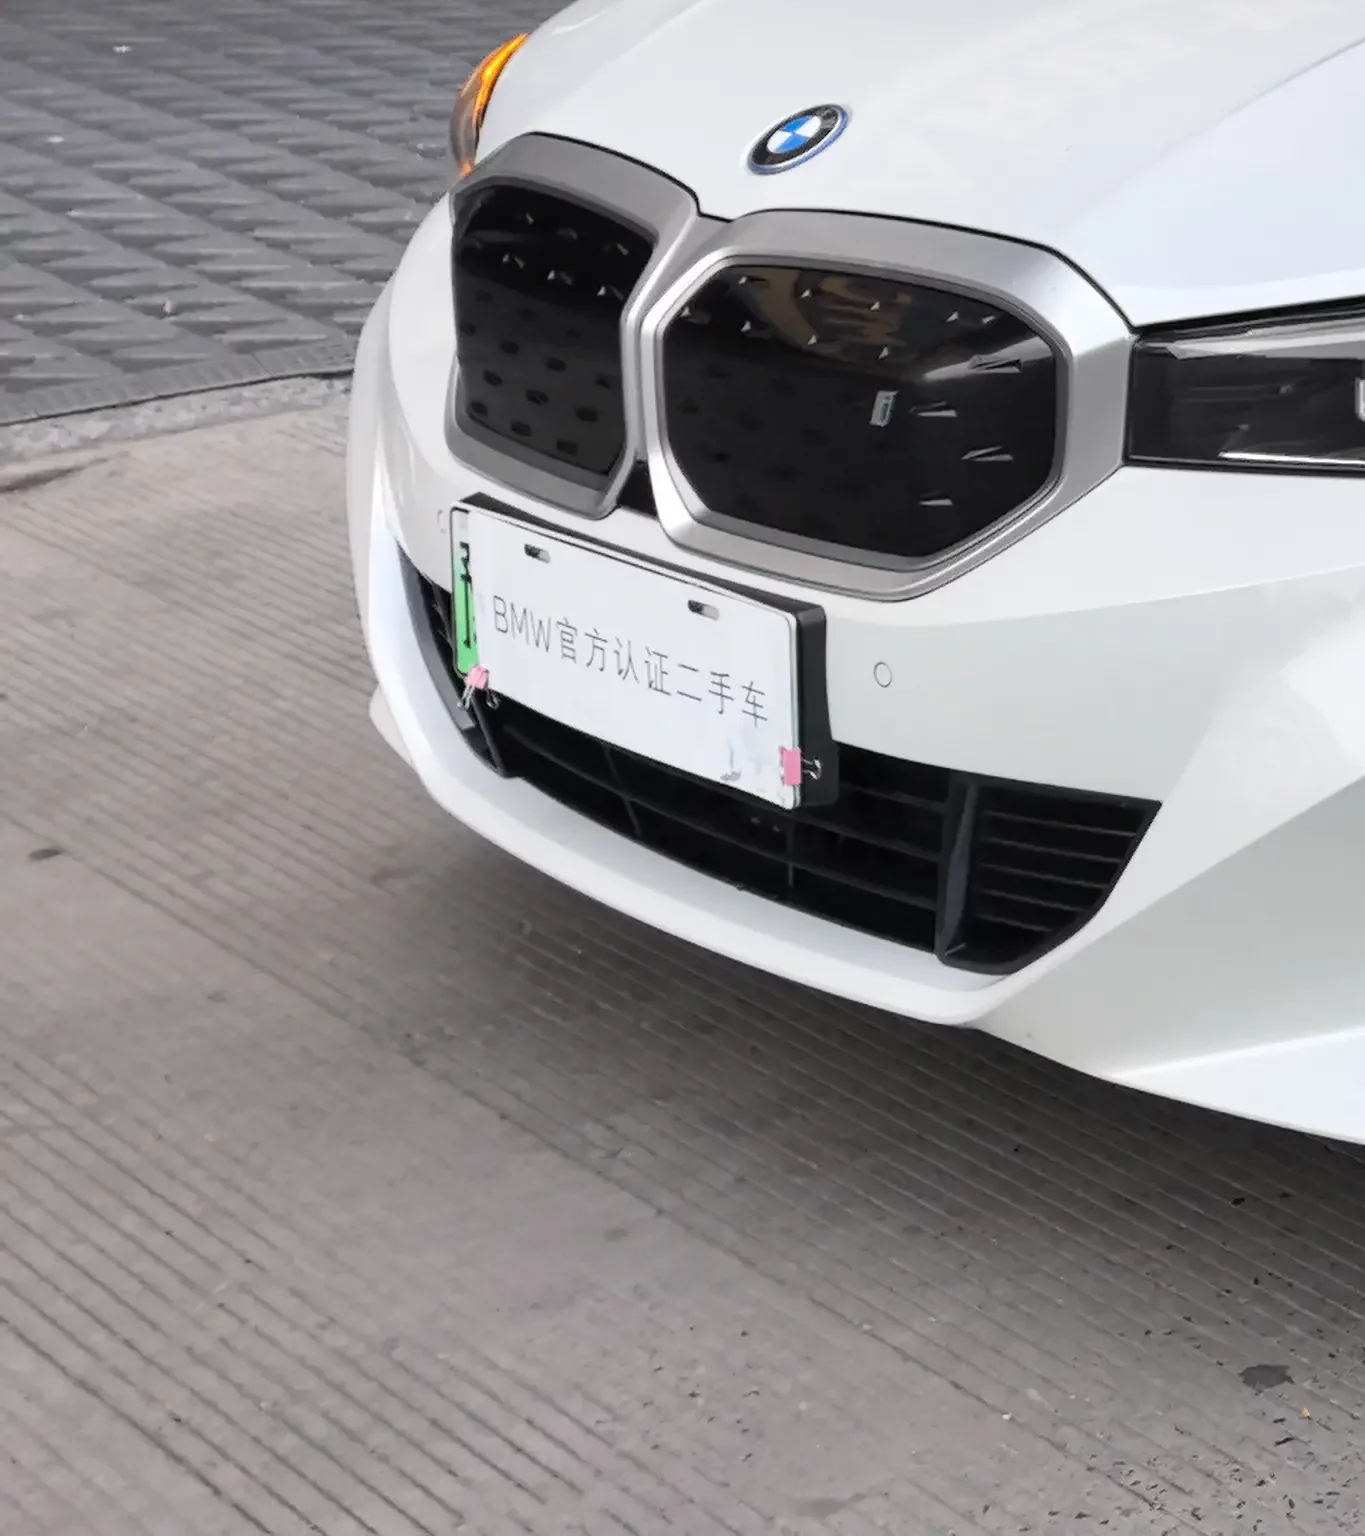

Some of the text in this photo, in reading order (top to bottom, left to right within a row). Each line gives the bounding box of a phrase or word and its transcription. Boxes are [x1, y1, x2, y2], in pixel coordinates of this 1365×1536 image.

[493, 595, 769, 727] BMW官方认证二手车
